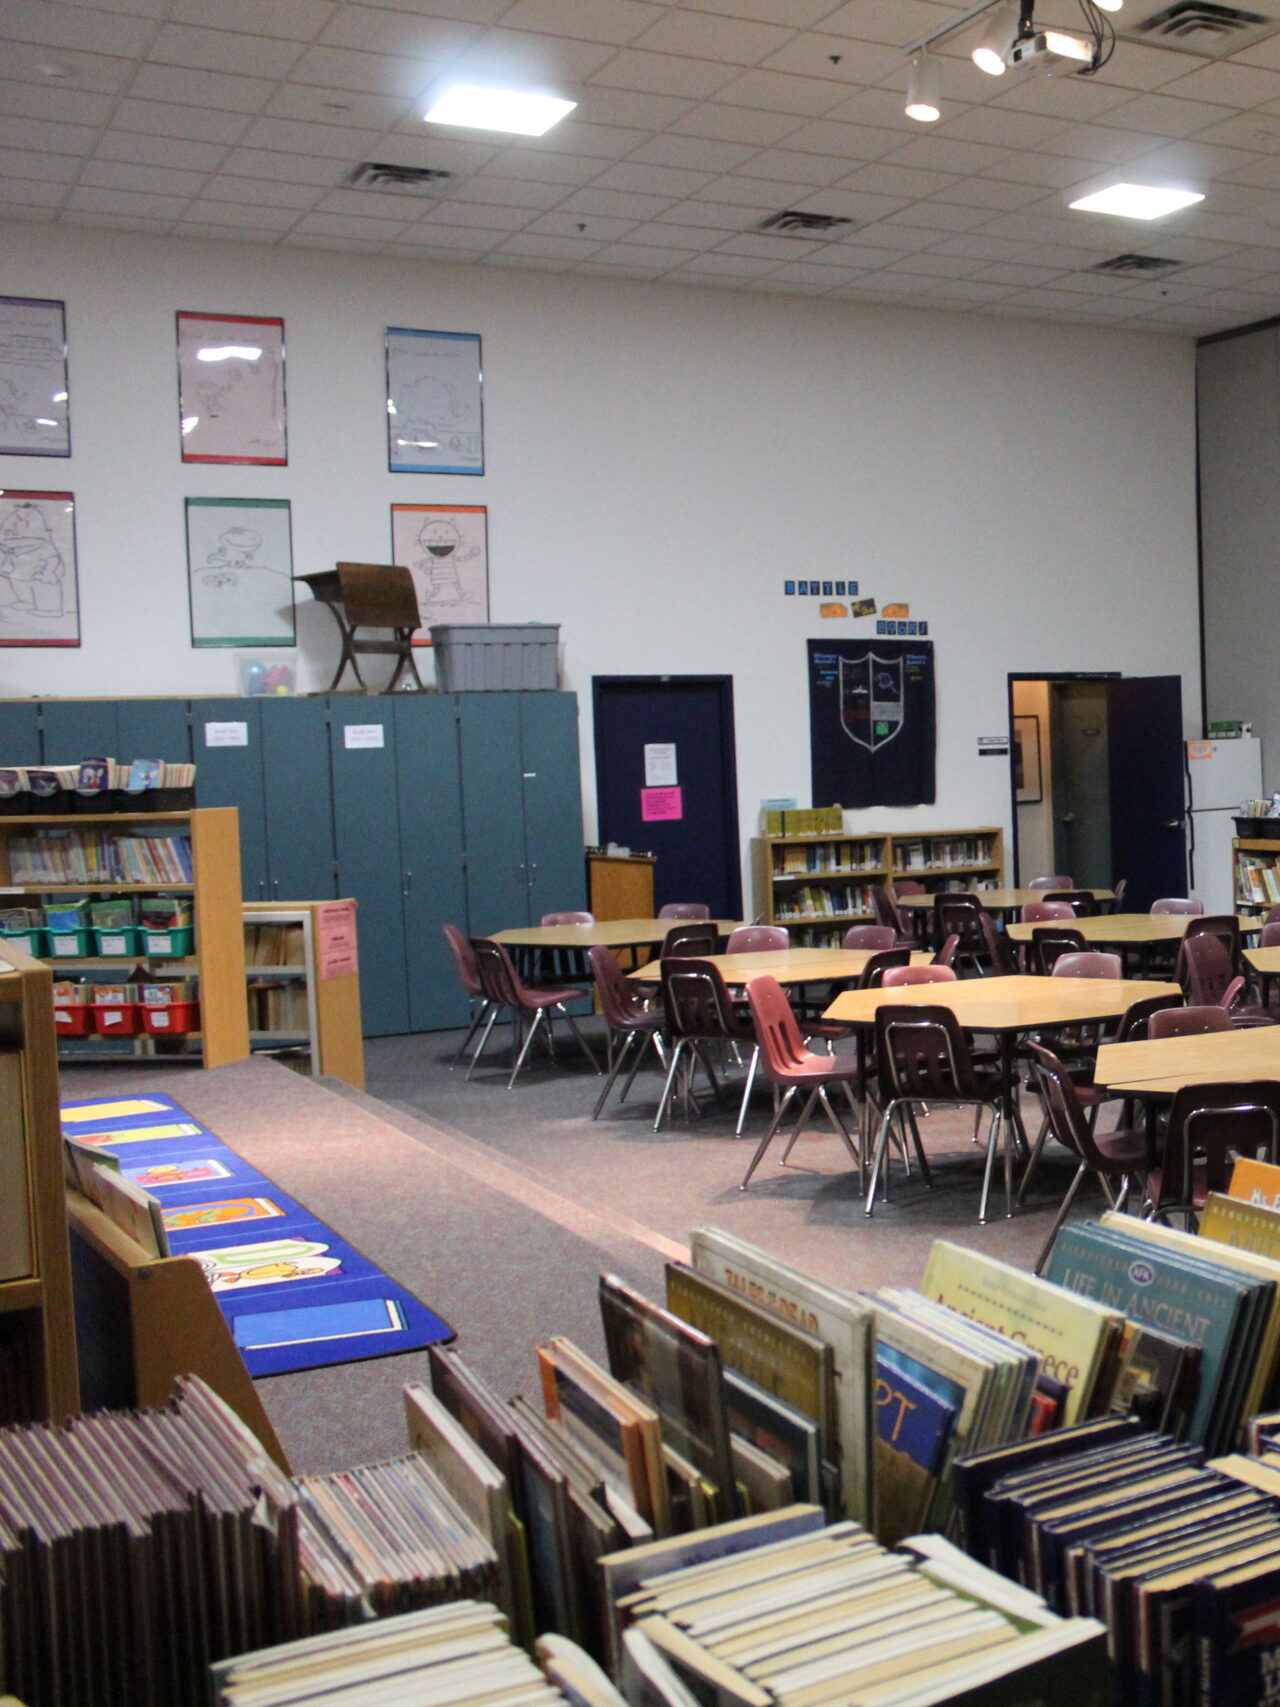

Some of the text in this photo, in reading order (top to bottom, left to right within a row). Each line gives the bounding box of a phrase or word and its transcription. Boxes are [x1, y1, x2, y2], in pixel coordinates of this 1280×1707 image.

[785, 581, 858, 595] BATTLE
[877, 621, 927, 635] BOOKS
[1062, 1268, 1096, 1298] LIFE
[1101, 1281, 1122, 1309] IN
[1127, 1293, 1212, 1342] ANCIENT
